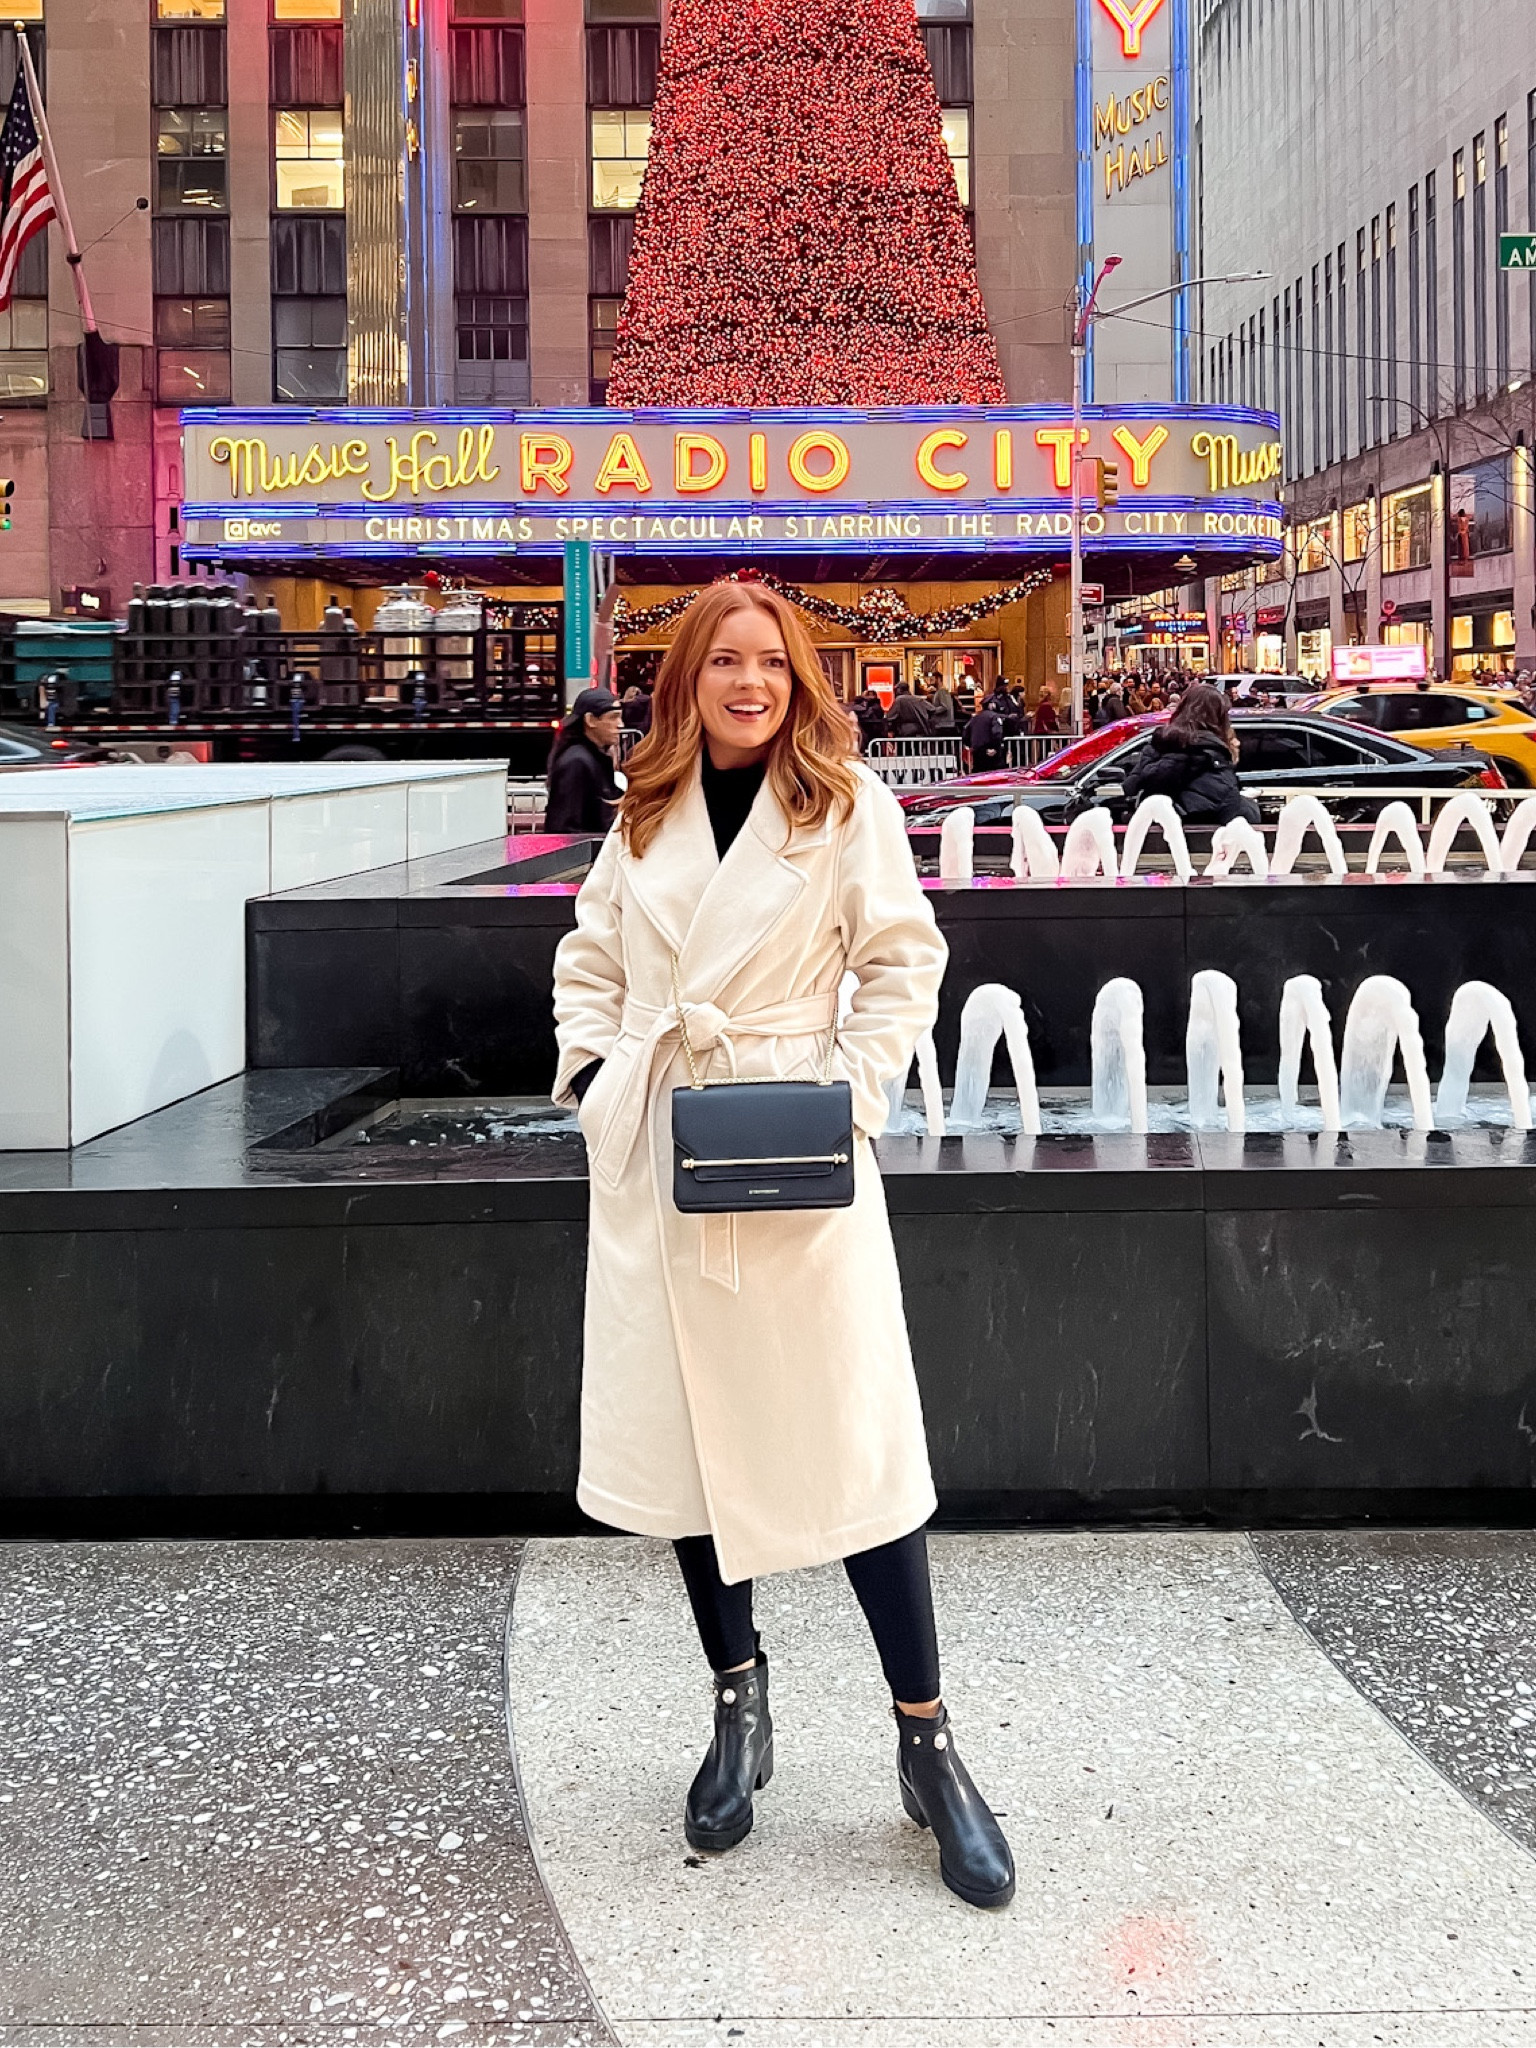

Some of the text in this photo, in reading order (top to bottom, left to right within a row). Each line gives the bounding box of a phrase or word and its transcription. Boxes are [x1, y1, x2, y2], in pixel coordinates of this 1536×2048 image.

[1095, 76, 1168, 150] MUSIC
[1106, 131, 1168, 199] HALL
[209, 424, 500, 502] Music Hall
[520, 424, 1171, 495] RADIO CITY
[365, 517, 532, 540] CHRISTMAS
[555, 515, 763, 540] SPECTACULAR
[785, 514, 921, 538] STARRING
[945, 513, 994, 536] THE
[1016, 512, 1105, 535] RADO
[1125, 511, 1186, 534] CITY
